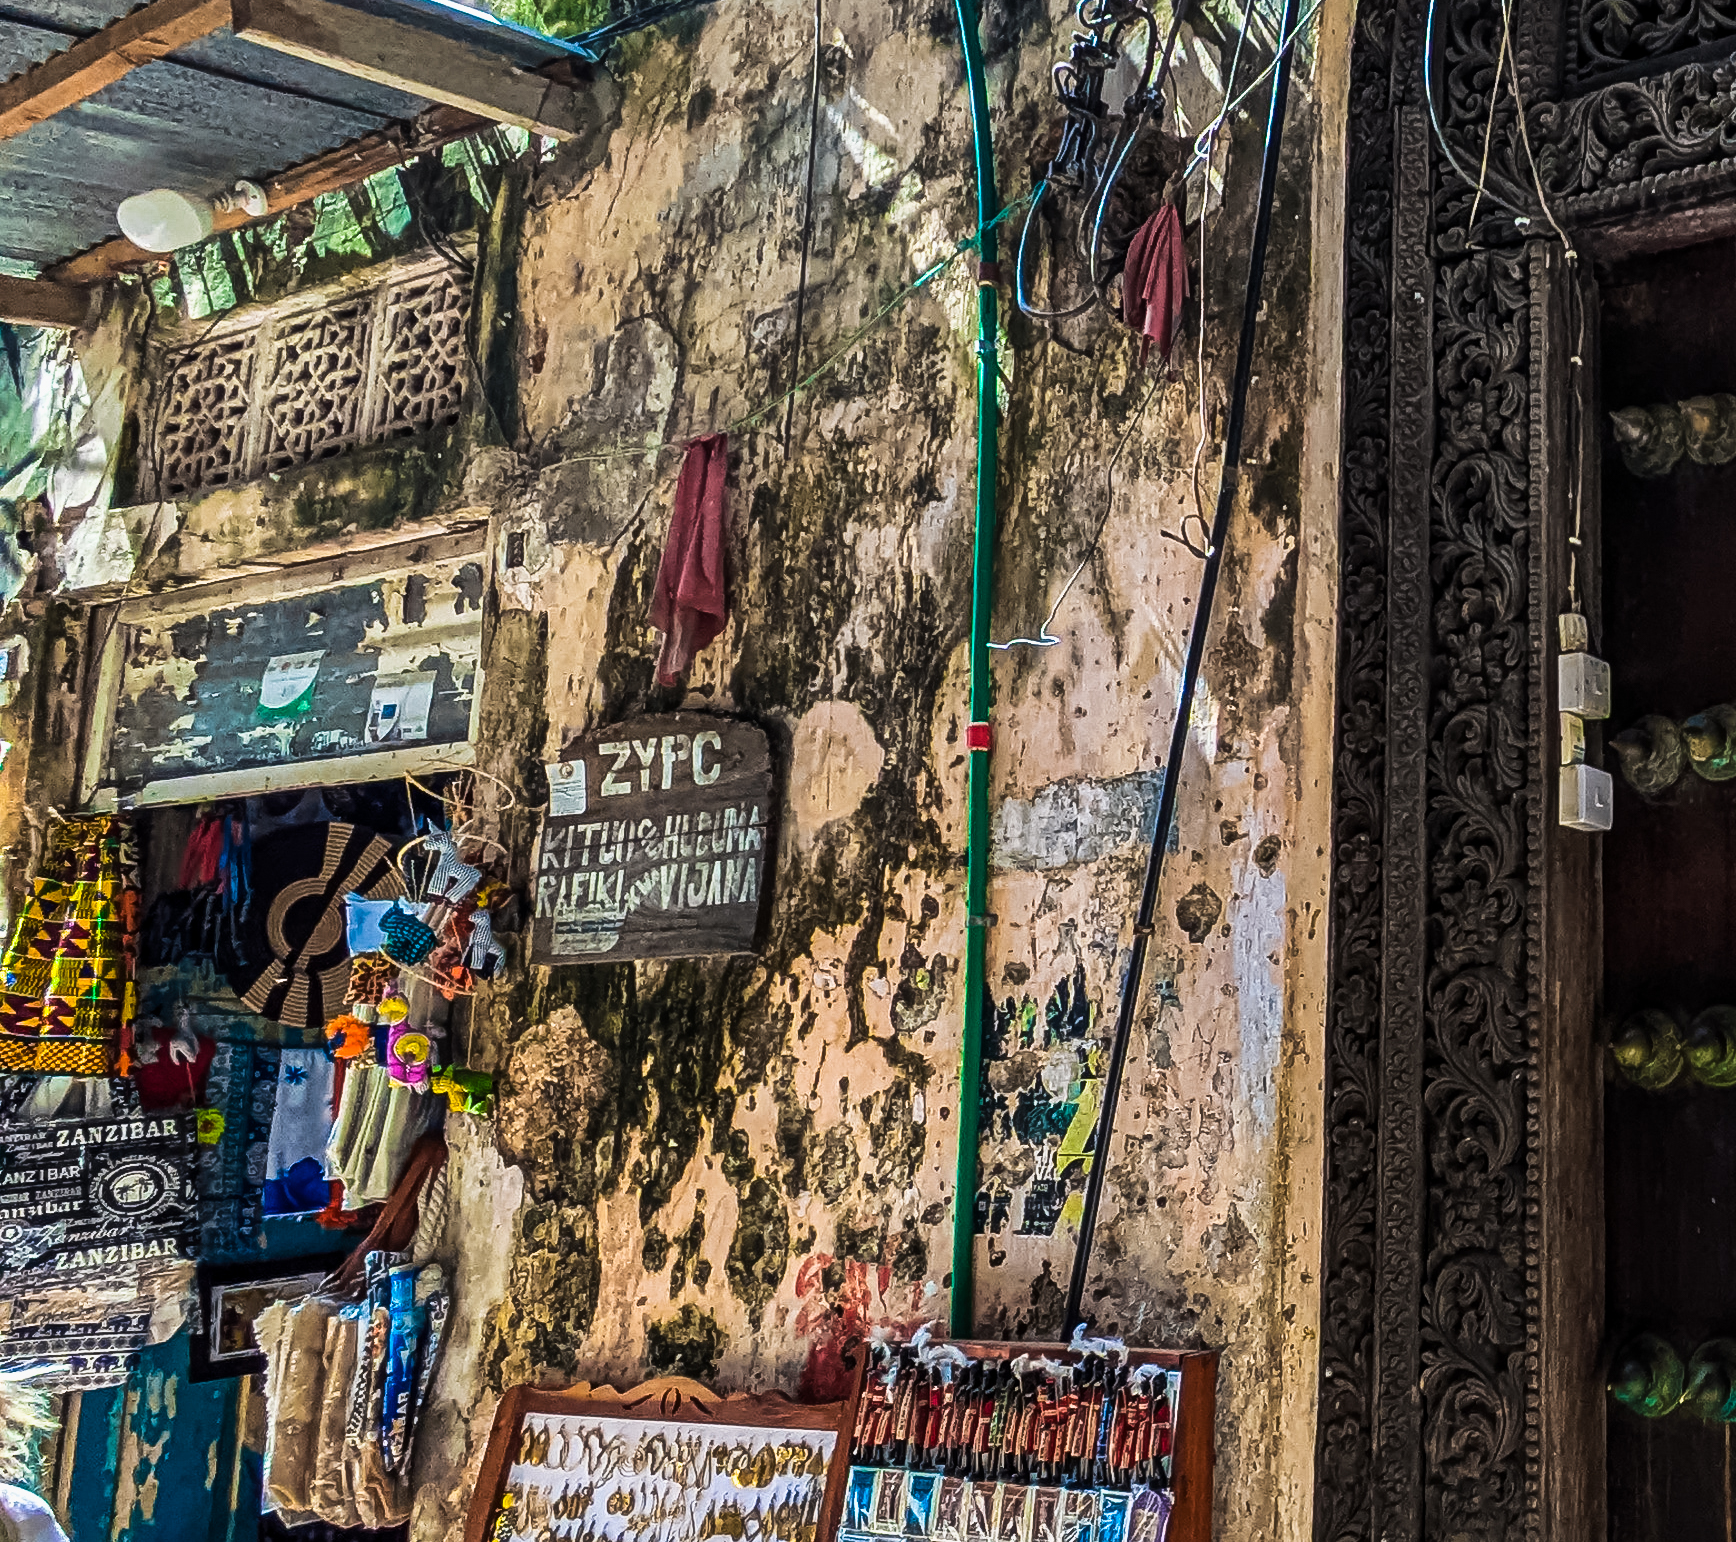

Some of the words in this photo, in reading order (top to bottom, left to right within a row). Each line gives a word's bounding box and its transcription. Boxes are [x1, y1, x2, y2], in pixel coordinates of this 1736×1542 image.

[598, 730, 722, 797] ZYPC
[535, 869, 625, 920] RAFIKI
[660, 857, 757, 911] VIJANA
[56, 1119, 179, 1148] ZANZIBAR
[0, 1165, 81, 1186] ANZIBAR
[55, 1238, 179, 1271] ZANZIBAR
